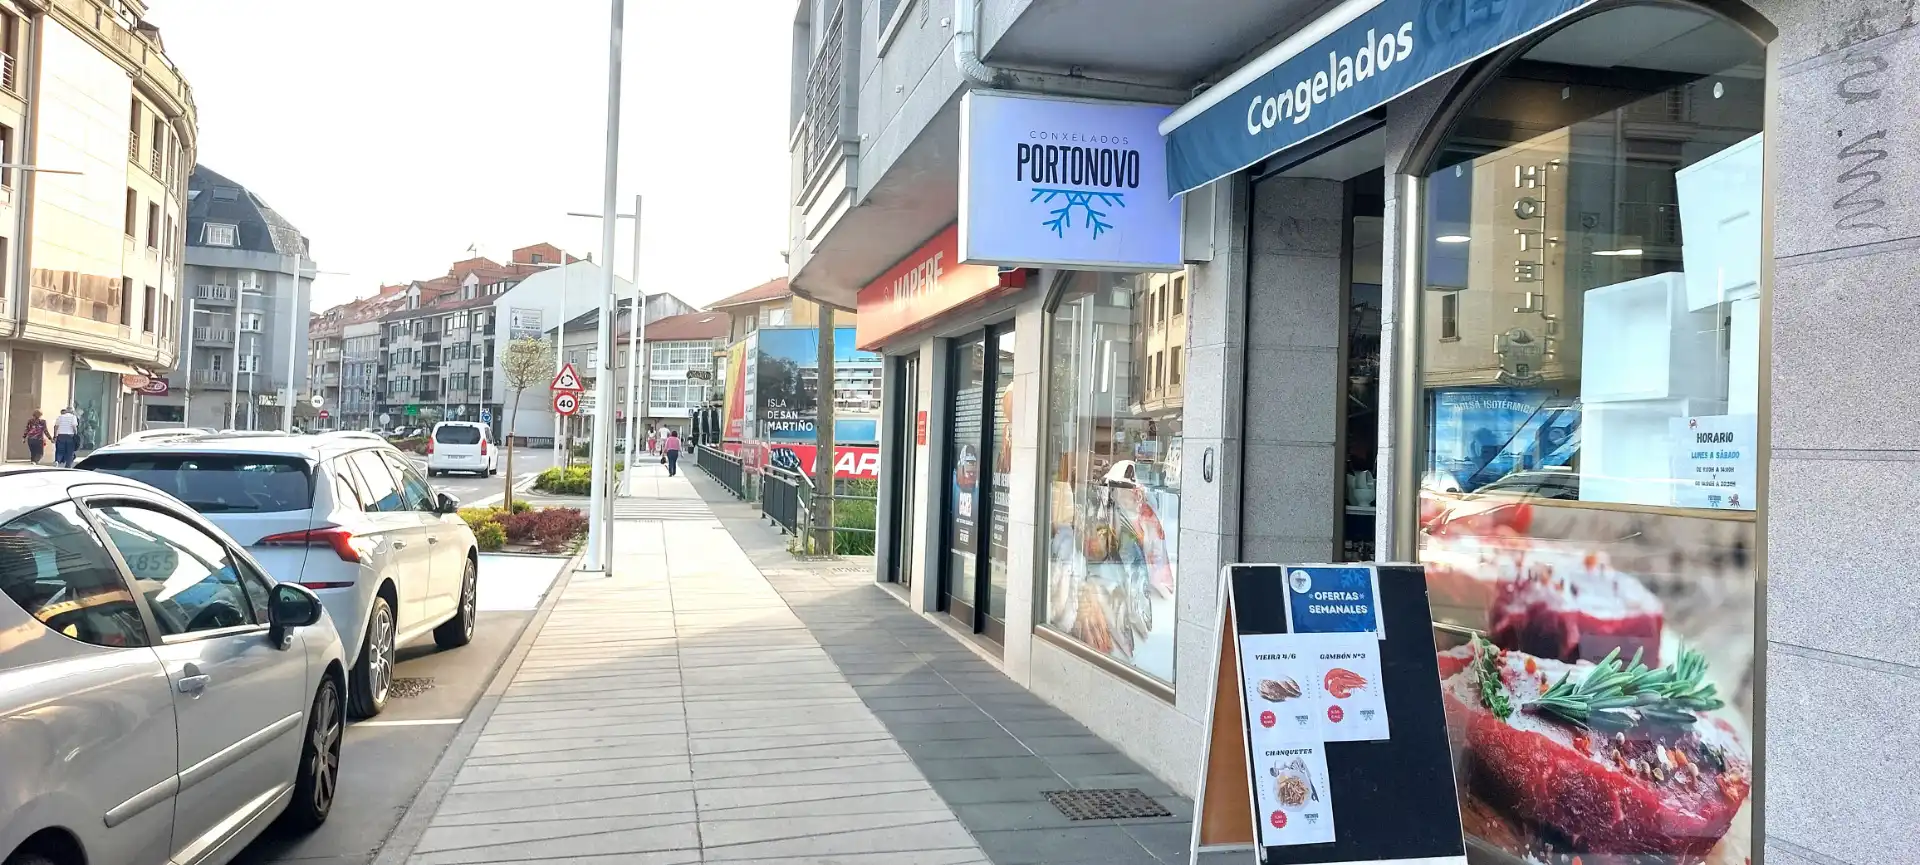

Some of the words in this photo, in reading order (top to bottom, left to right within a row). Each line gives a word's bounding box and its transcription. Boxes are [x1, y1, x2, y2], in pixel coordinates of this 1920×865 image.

[1247, 21, 1414, 136] Congelados
[1029, 130, 1129, 145] CONXELADOS
[1017, 143, 1140, 189] PORTONOVO
[893, 250, 944, 311] MAPFRE
[559, 399, 573, 409] 40
[767, 398, 787, 408] ISLA
[767, 419, 814, 432] MARTIÑO
[1696, 431, 1734, 444] HORARIO
[1691, 451, 1708, 459] LUNES
[1709, 451, 1714, 459] A
[1715, 449, 1740, 459] SÁBADO
[1314, 591, 1360, 601] OFERTAS
[1308, 604, 1369, 615] SEMANALES
[1255, 653, 1281, 661] VIEIRA
[1319, 651, 1351, 660] GAMBÓN
[1265, 748, 1313, 757] CHANQUETES
